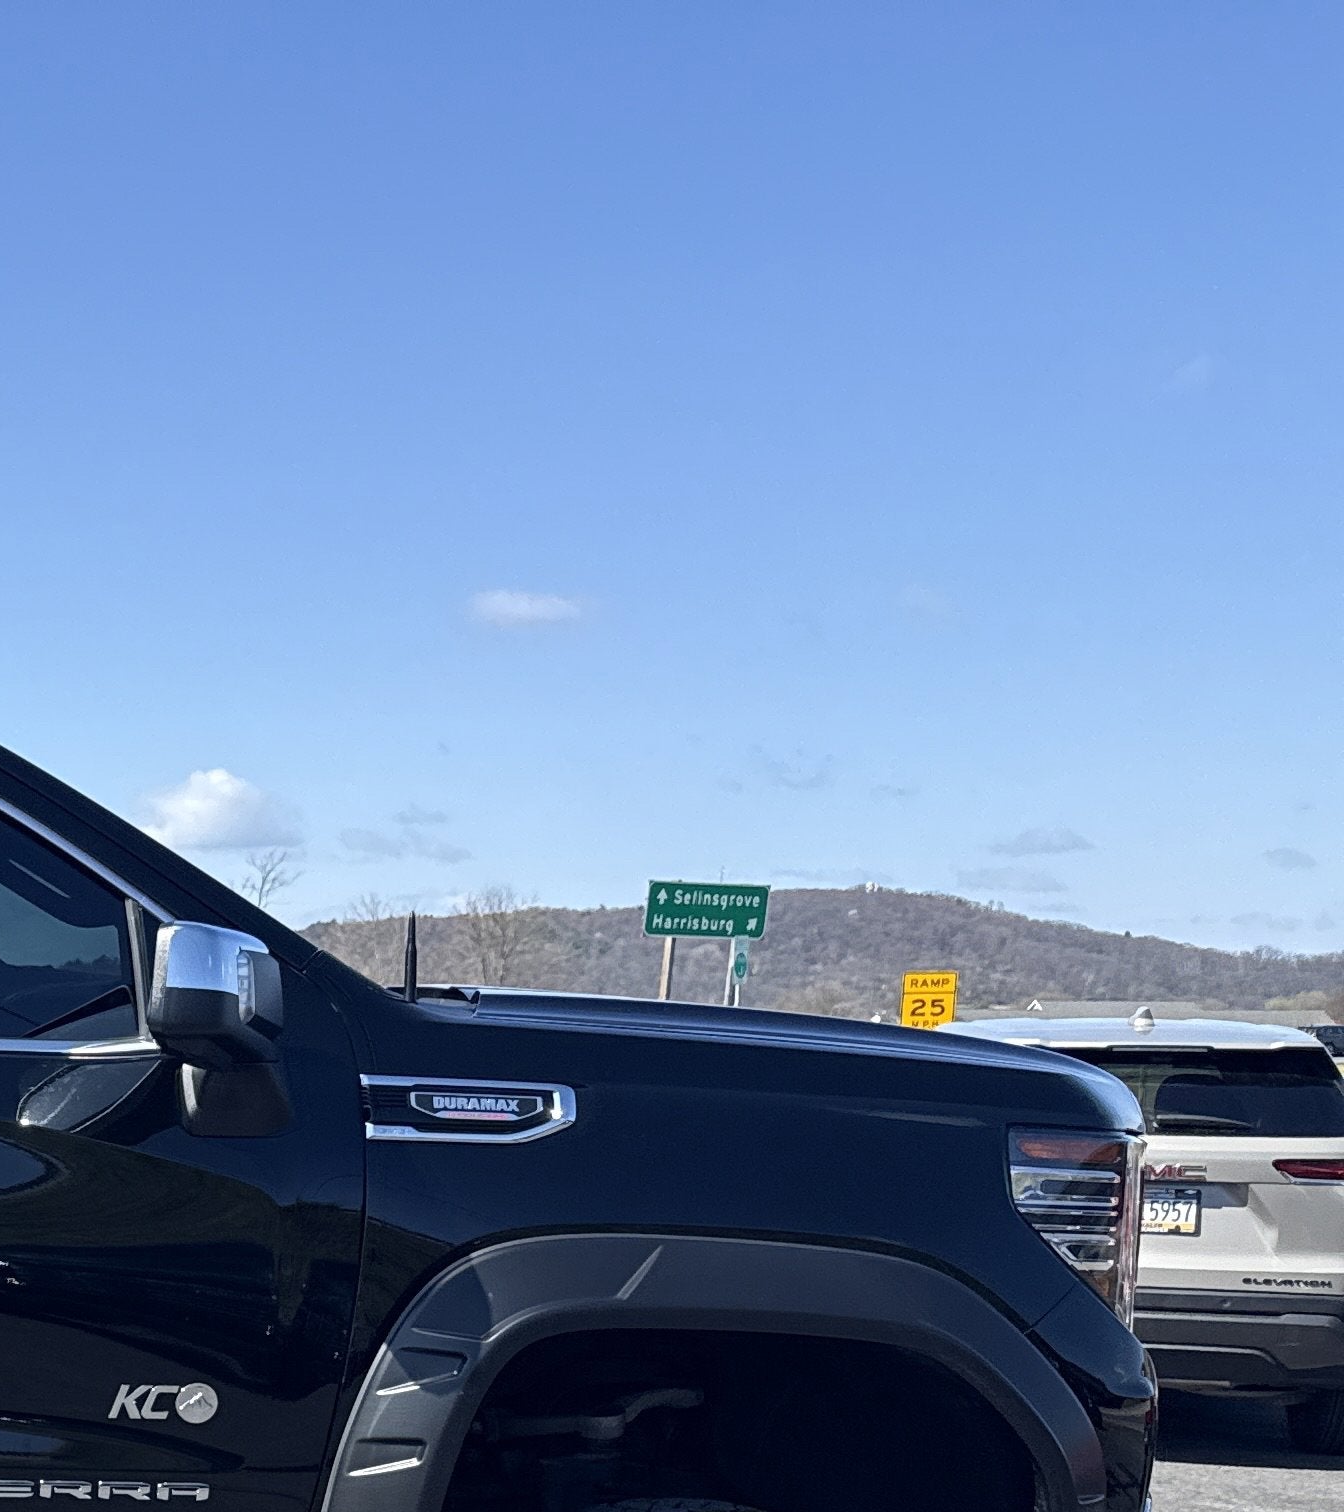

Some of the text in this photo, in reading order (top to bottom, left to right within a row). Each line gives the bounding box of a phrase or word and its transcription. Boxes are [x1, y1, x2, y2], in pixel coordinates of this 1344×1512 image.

[673, 889, 760, 911] Selinsgrove
[652, 913, 734, 936] Harrisburg
[910, 978, 951, 988] RAMP
[910, 999, 945, 1017] 25
[432, 1096, 520, 1112] DURAMAX
[1143, 1165, 1207, 1182] MC
